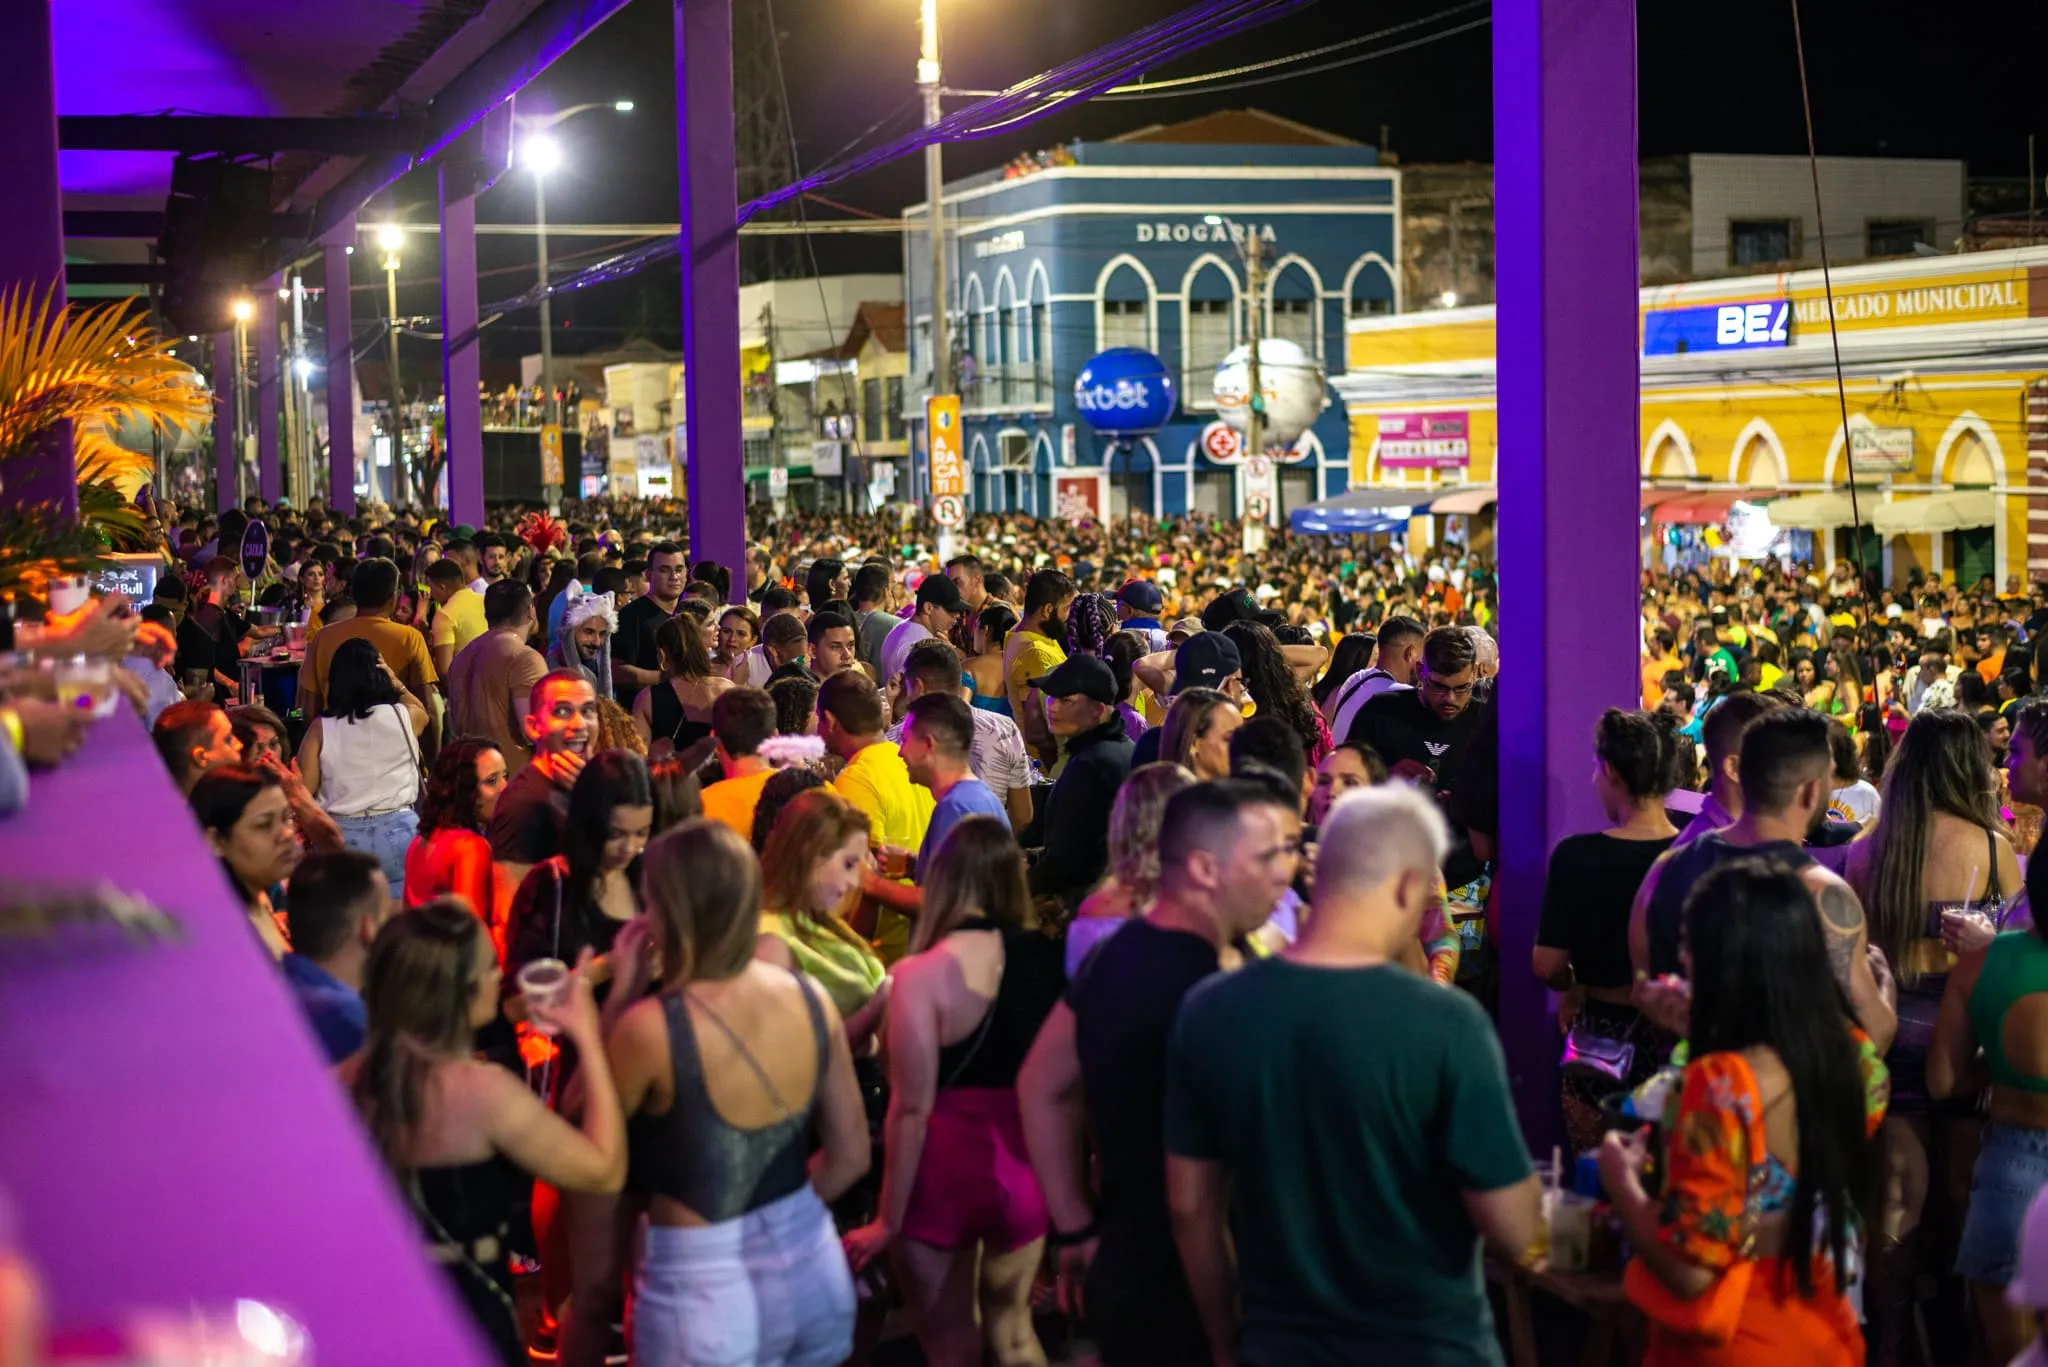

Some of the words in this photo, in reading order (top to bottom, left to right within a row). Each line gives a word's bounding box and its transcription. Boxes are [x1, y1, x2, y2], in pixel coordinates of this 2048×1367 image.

[1136, 222, 1277, 243] DROGARIA
[1793, 291, 1890, 323] MERCADO
[1896, 281, 2018, 316] MUNICIPAL
[120, 582, 143, 595] Bull
